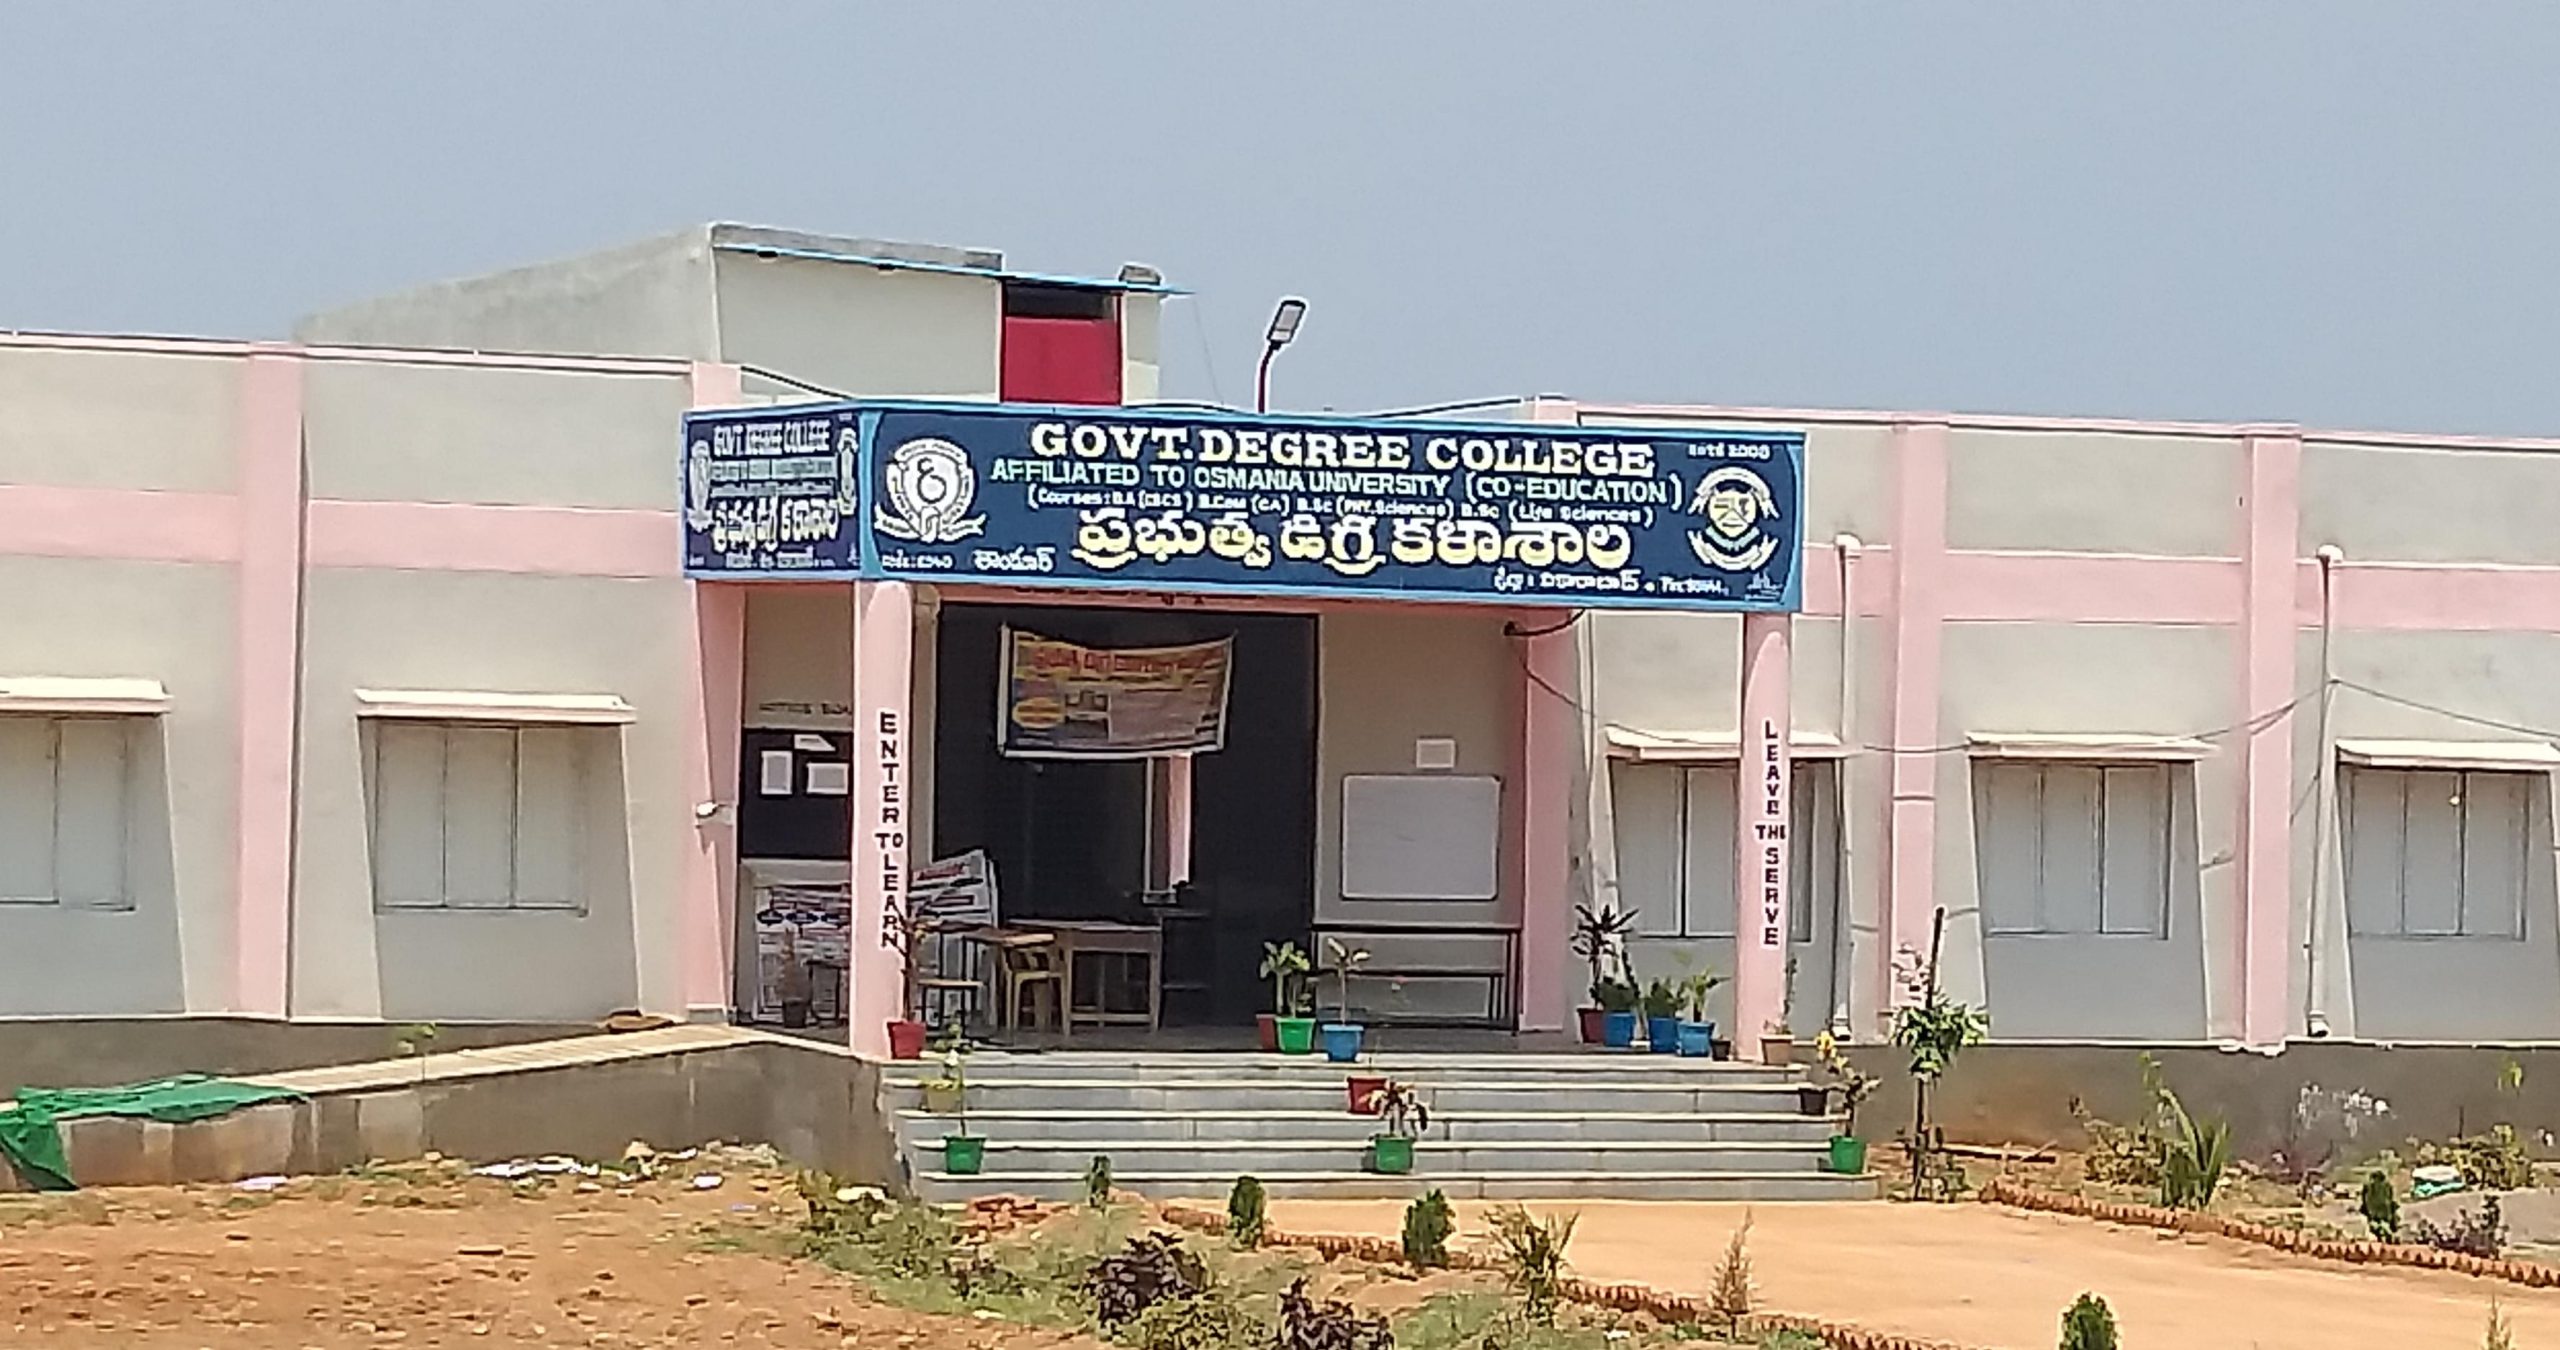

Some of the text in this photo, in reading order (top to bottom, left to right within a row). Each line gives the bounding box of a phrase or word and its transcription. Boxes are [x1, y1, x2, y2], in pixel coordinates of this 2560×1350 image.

[990, 458, 1140, 487] AFFILIATED
[1151, 464, 1185, 488] TO
[1193, 466, 1305, 491] OSMANIA
[1308, 470, 1450, 497] UNIVERSITY
[1426, 438, 1655, 479] COLLEGE
[1071, 507, 1272, 569] ప్రభుత్వ
[1392, 516, 1632, 570] కళాశాల
[1765, 720, 1780, 816] LEAVE
[875, 712, 904, 948] ENTER TO LEARN
[1764, 848, 1779, 945] SERVE
